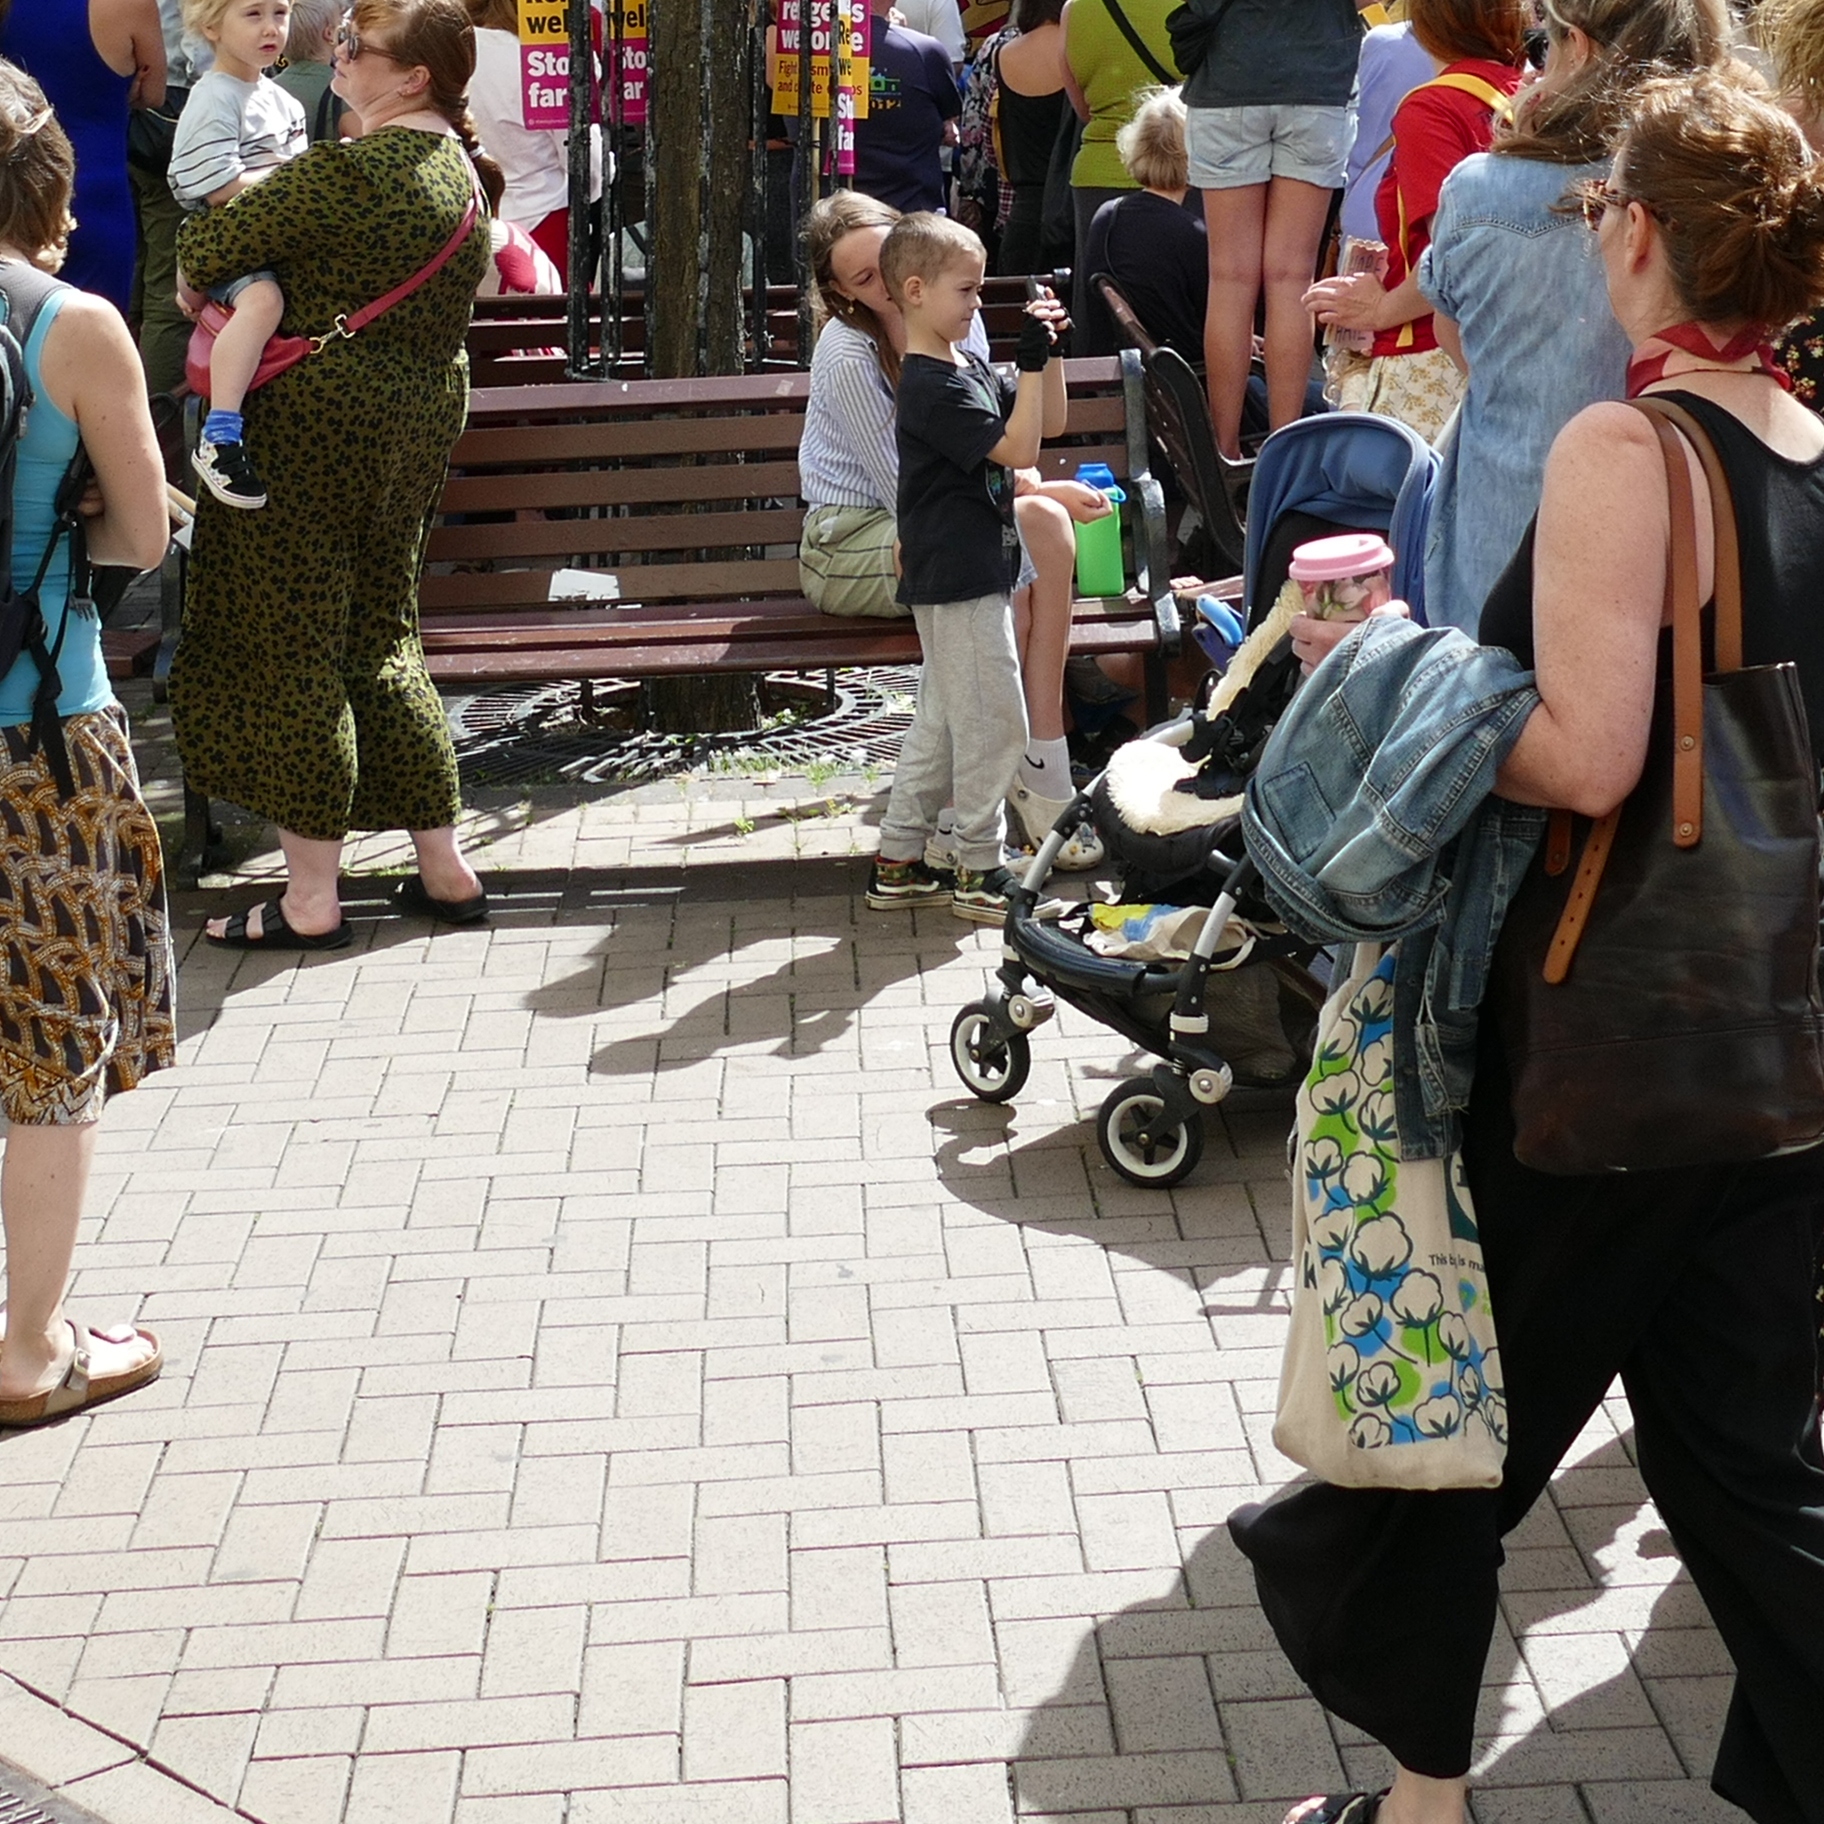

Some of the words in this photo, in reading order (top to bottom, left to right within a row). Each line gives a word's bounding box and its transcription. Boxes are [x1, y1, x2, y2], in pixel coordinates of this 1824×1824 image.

[527, 50, 569, 76] Sto
[528, 82, 567, 108] far
[1428, 1253, 1448, 1266] This
[1468, 1259, 1485, 1273] ma
